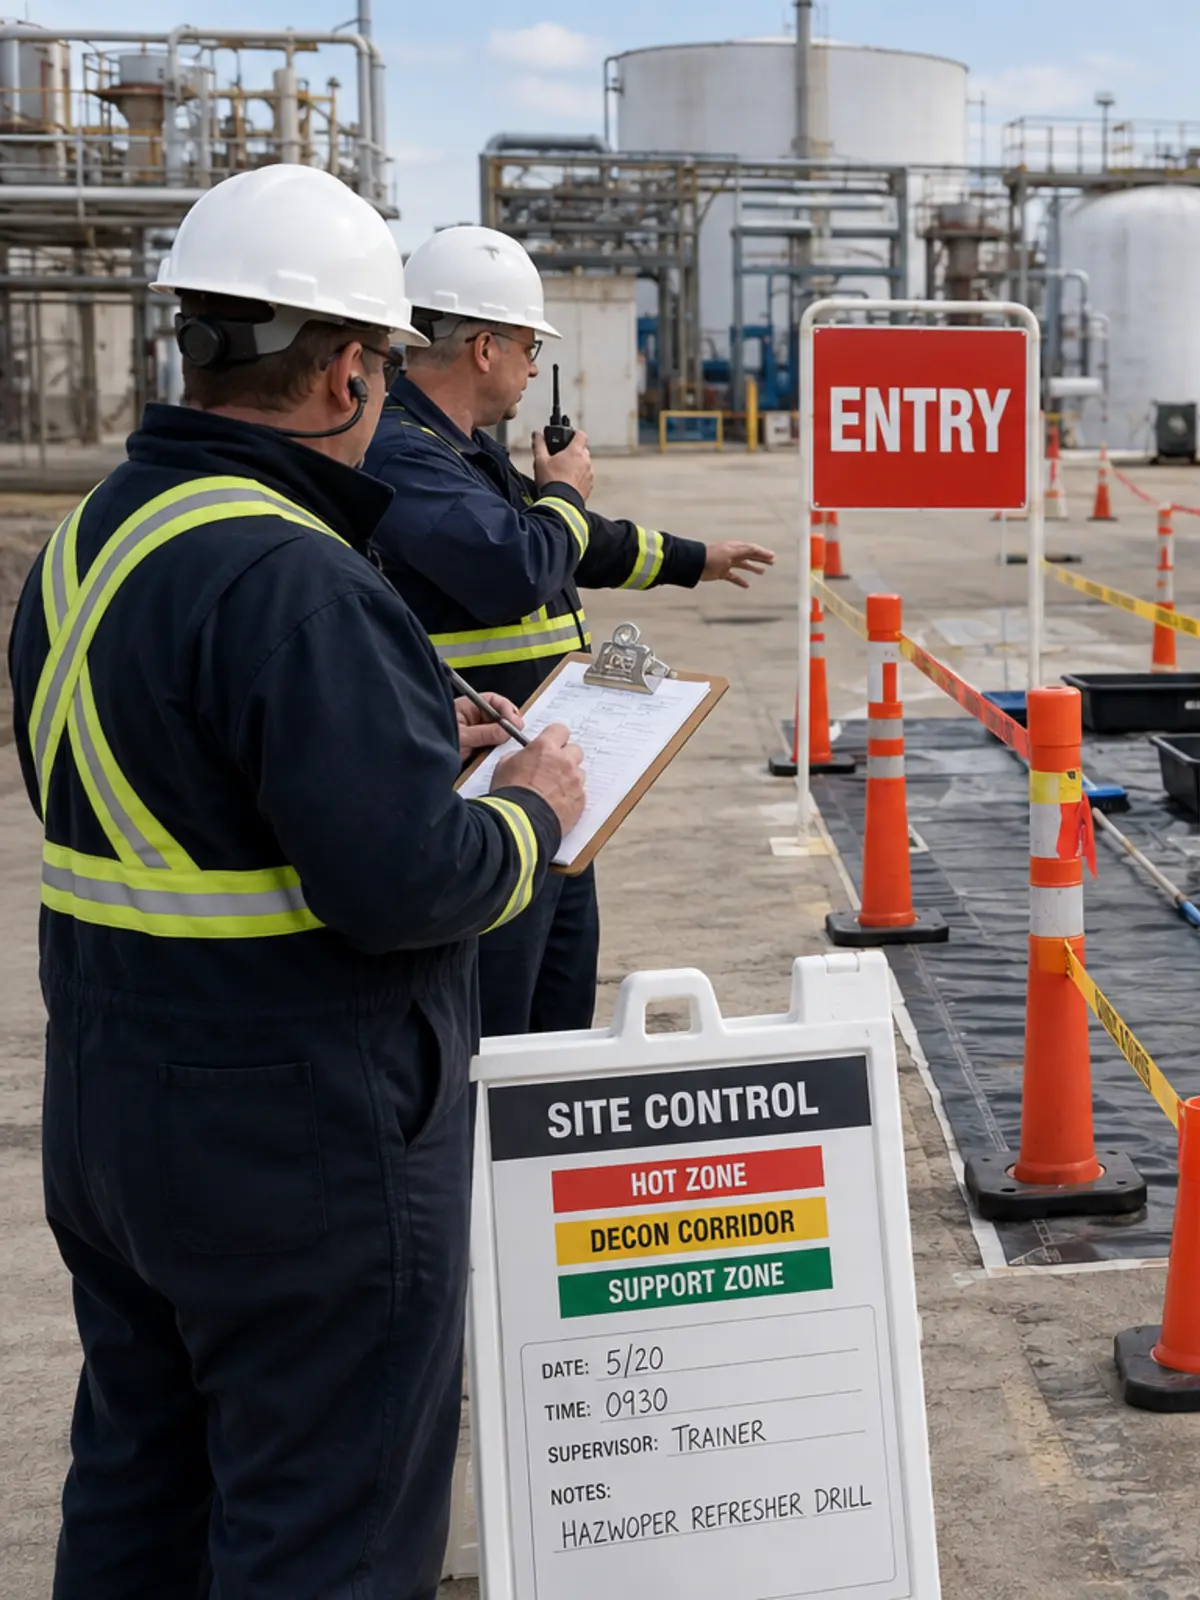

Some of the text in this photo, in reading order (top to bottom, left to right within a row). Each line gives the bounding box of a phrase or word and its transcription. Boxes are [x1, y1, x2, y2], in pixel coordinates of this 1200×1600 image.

[830, 386, 1011, 452] ENTRY
[548, 1081, 819, 1138] SITE CONTROL
[631, 1162, 747, 1196] HOT ZONE
[590, 1209, 795, 1252] DECON CORRIDOR
[608, 1262, 784, 1304] SUPPORT ZONE
[542, 1358, 589, 1379] DATE:
[606, 1344, 664, 1378] 5/20
[544, 1401, 591, 1421] TIME:
[606, 1387, 668, 1418] 0930
[548, 1435, 659, 1464] SUPERVISOR:
[671, 1419, 766, 1452] TRAINER
[551, 1483, 611, 1505] NOTES:
[562, 1485, 872, 1548] HAZWOPER REFRESHER DRILL
